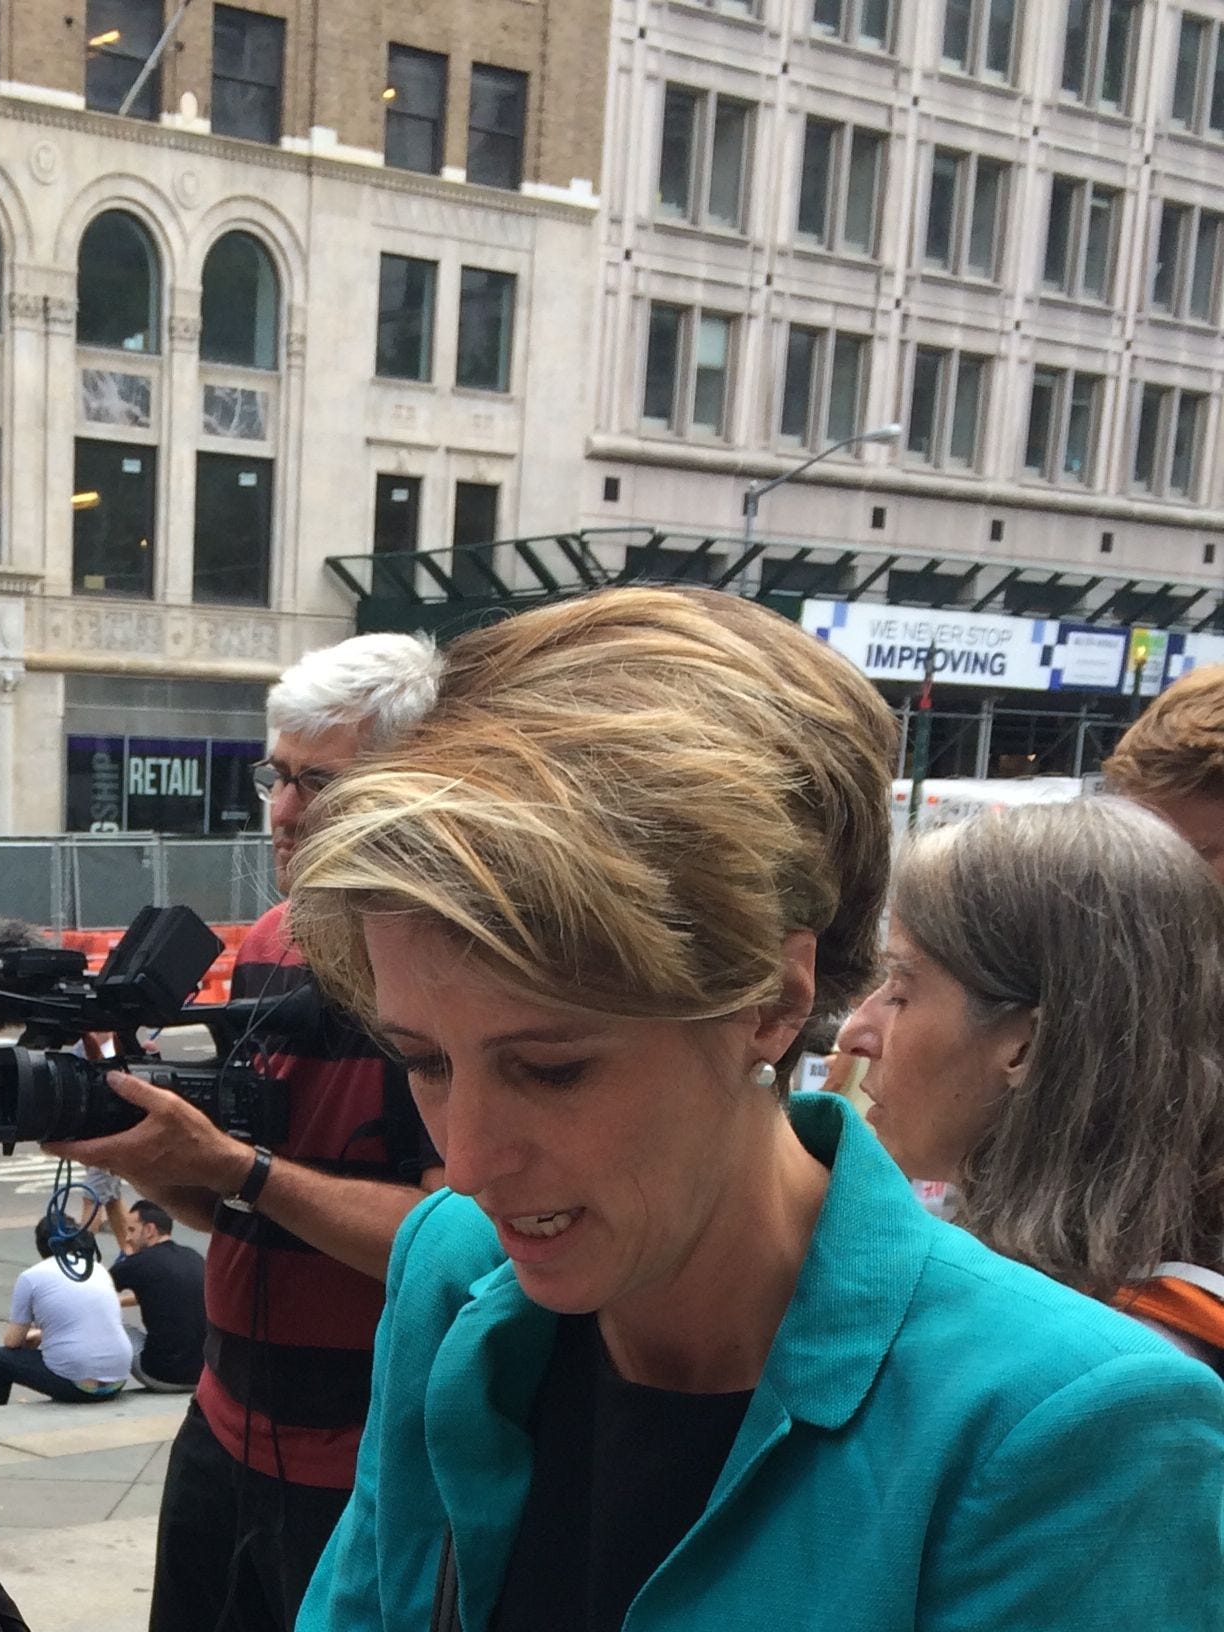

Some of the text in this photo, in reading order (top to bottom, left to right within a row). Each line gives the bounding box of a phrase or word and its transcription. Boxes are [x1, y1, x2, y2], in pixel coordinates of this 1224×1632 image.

[869, 618, 1013, 648] WE NEVER STOP
[865, 642, 1007, 677] IMPROVING
[129, 756, 204, 797] RETAIL
